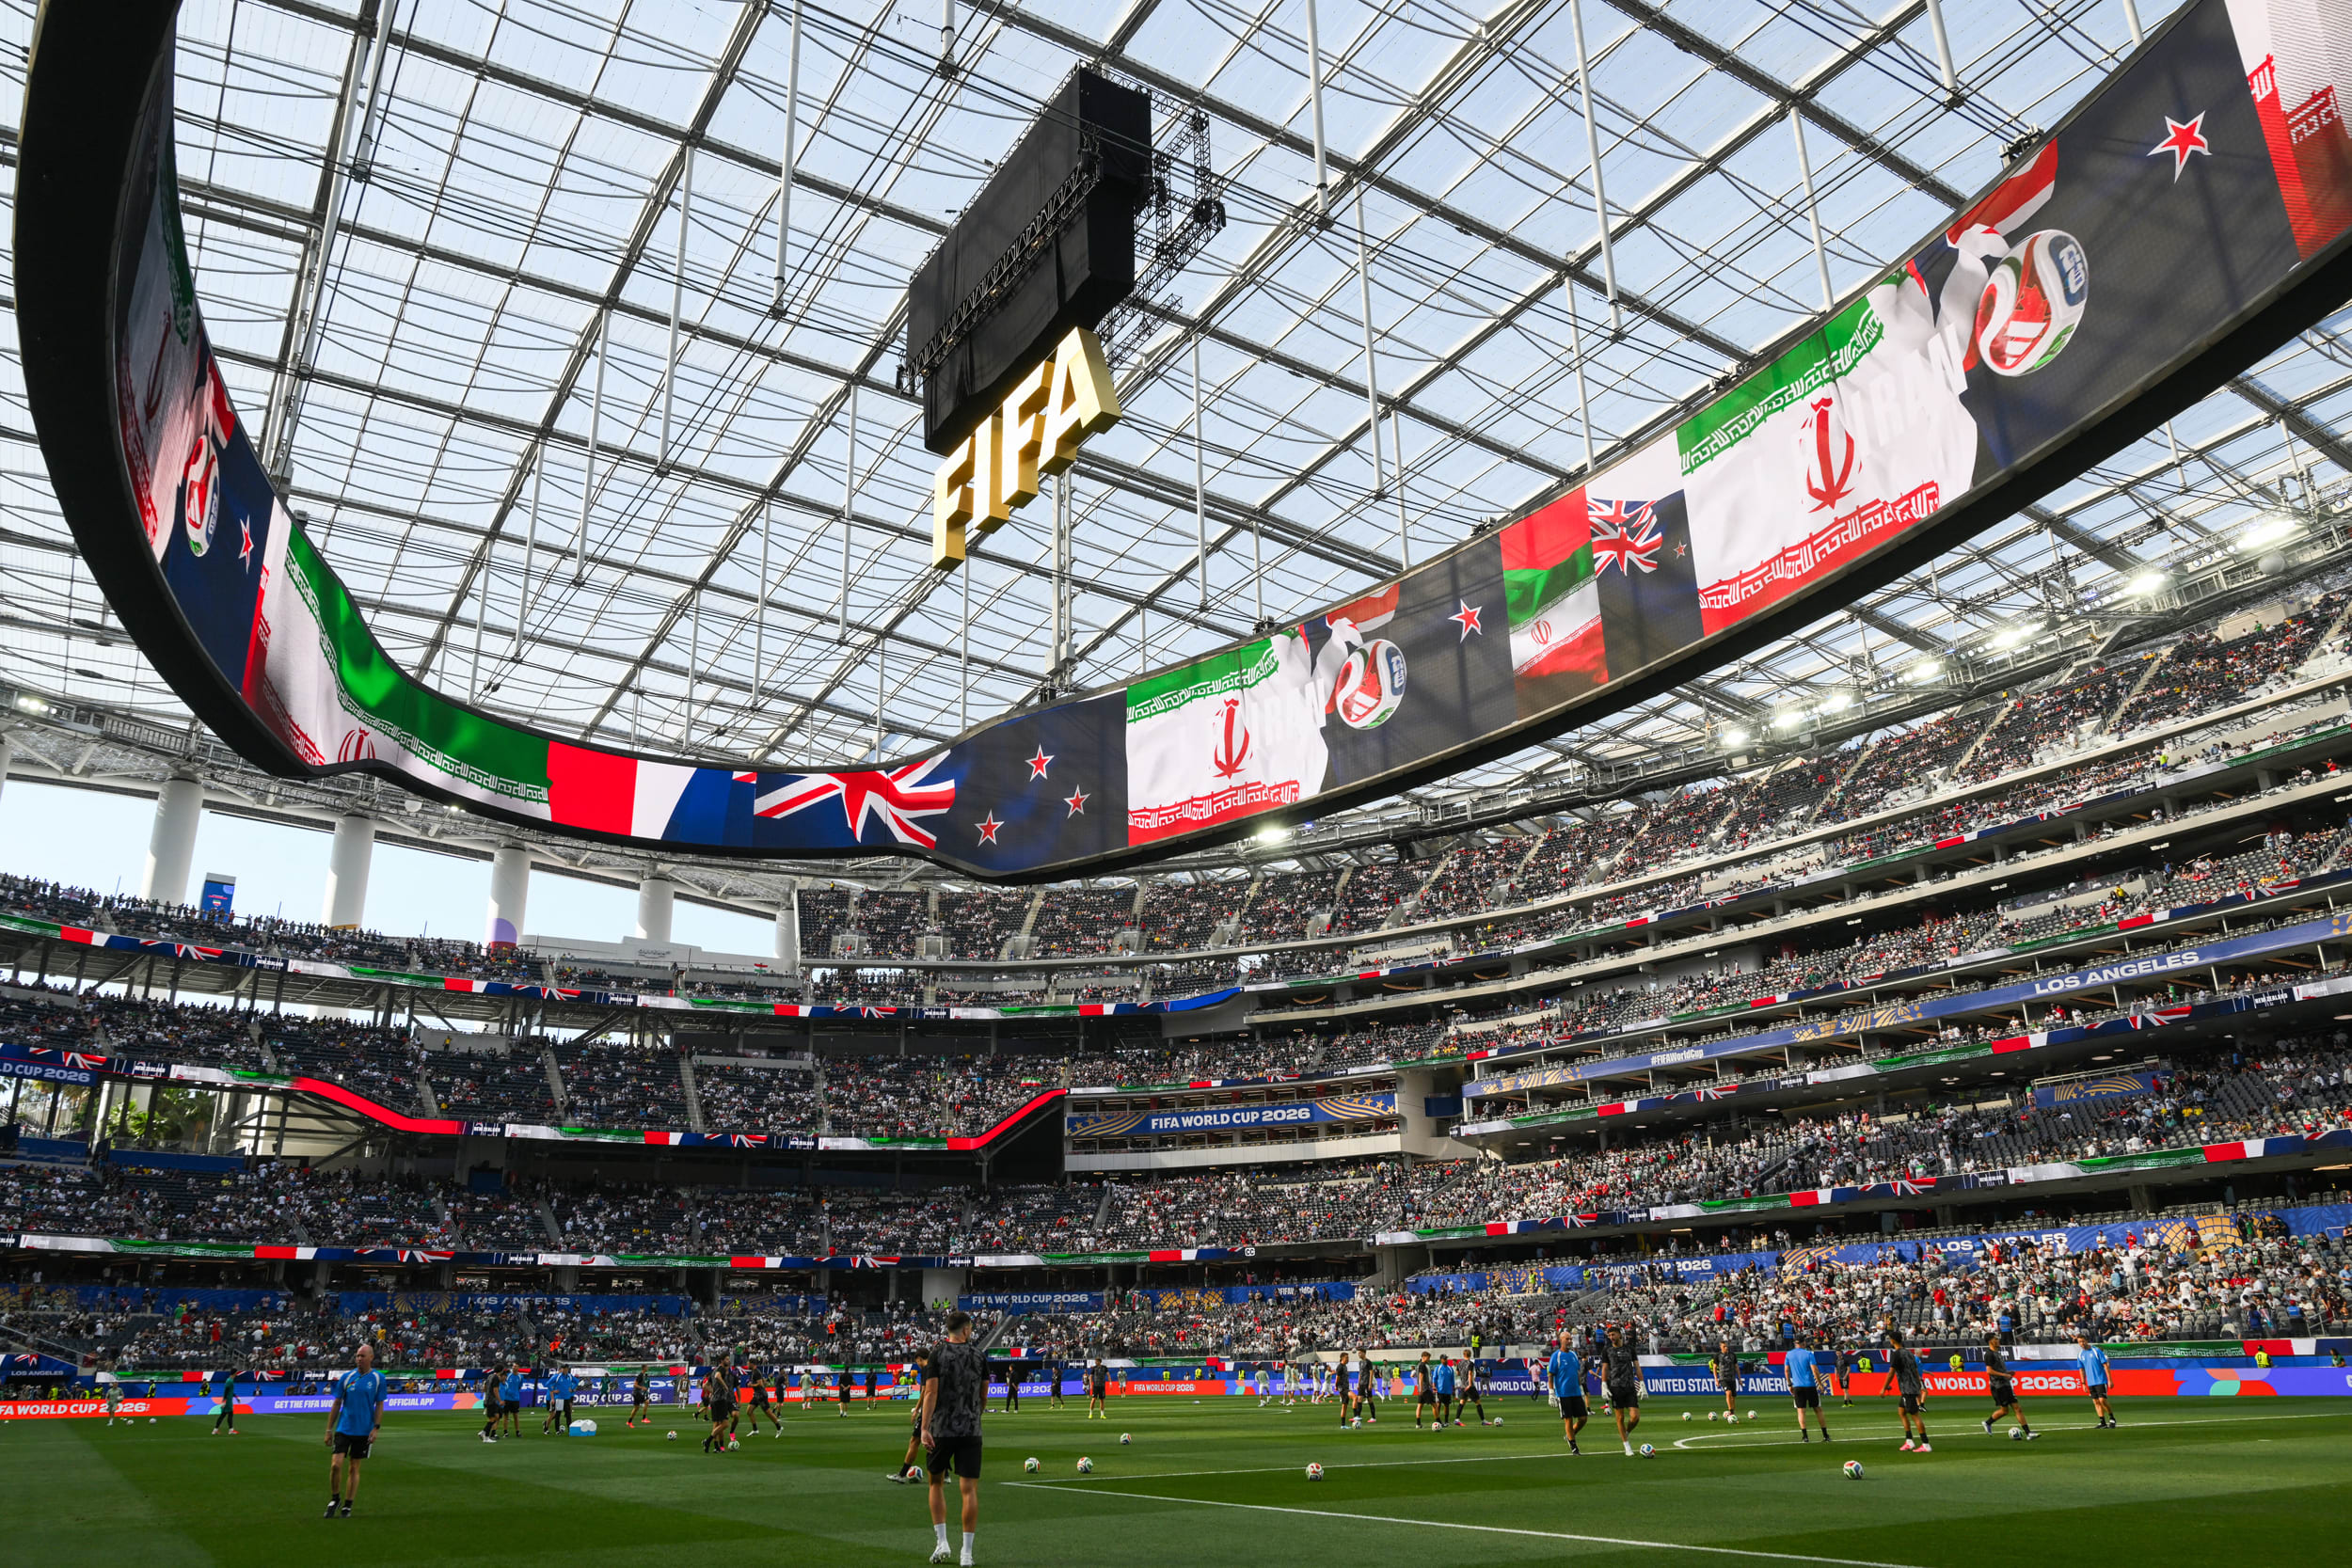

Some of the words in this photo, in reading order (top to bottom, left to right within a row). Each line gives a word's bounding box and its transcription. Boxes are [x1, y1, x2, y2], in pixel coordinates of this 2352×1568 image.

[932, 325, 1121, 572] FIFA
[2034, 975, 2081, 994] LOS
[2086, 951, 2200, 985] ANGELES
[1651, 1049, 1704, 1066] #FIFAWorldCup
[14, 1064, 41, 1077] CUP
[43, 1068, 90, 1083] 2026
[1151, 1117, 1180, 1130] FIFA
[1181, 1114, 1231, 1129] WORLD
[1232, 1112, 1261, 1125] CUP
[1261, 1107, 1311, 1123] 2026
[1936, 1240, 1973, 1252] LOS
[1676, 1259, 1712, 1272] 2026
[994, 1295, 1030, 1304] WORLD
[1032, 1294, 1052, 1303] CUP
[1053, 1293, 1089, 1303] 2026
[1134, 1384, 1145, 1392] FIFA
[1146, 1384, 1165, 1392] WORLD
[1165, 1384, 1175, 1392] CUP
[1489, 1382, 1519, 1391] WORLD
[1647, 1378, 1687, 1392] UNITED
[1688, 1378, 1723, 1392] STATE
[1748, 1377, 1790, 1392] AMERI
[1933, 1377, 1986, 1390] WORLD
[2021, 1376, 2076, 1390] 2026
[987, 1386, 1009, 1395] ORL
[1032, 1385, 1052, 1393] 202
[274, 1400, 290, 1409] GET
[290, 1400, 304, 1409] THE
[304, 1400, 320, 1408] FIFA
[389, 1398, 418, 1407] OFFICIAL
[419, 1398, 435, 1406] APP
[573, 1394, 599, 1403] ORLD
[18, 1403, 68, 1416] WORLD
[69, 1402, 97, 1415] CUP
